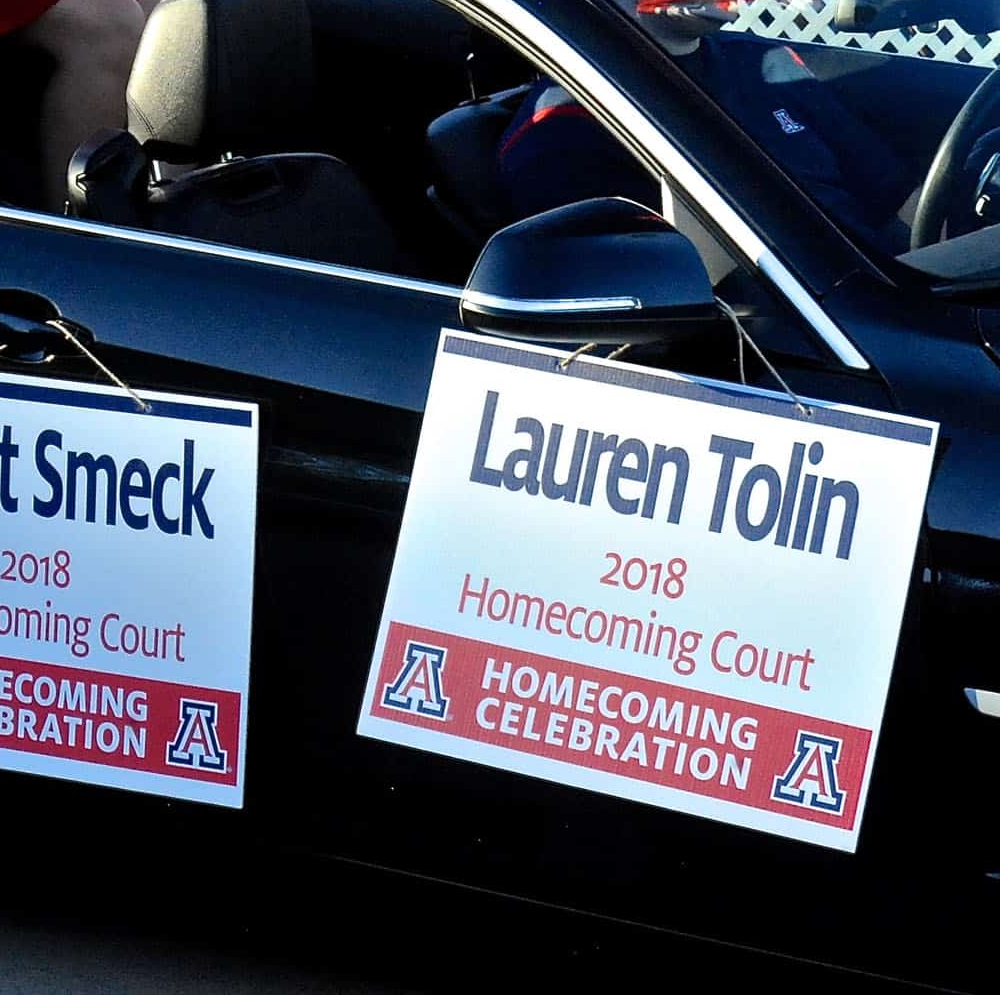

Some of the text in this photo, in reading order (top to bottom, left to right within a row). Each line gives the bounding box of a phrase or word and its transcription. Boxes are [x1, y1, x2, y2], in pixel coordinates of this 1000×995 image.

[33, 429, 216, 539] Smeck
[469, 390, 860, 560] Lauren Tolin
[0, 550, 71, 589] 2018
[600, 551, 688, 599] 2018
[100, 613, 186, 662] Court
[458, 573, 815, 691] Homecoming Court
[380, 640, 451, 721] A
[481, 658, 759, 751] HOMECOMING
[165, 698, 228, 774] A
[476, 696, 752, 790] CELEBRATION
[770, 729, 845, 815] A
